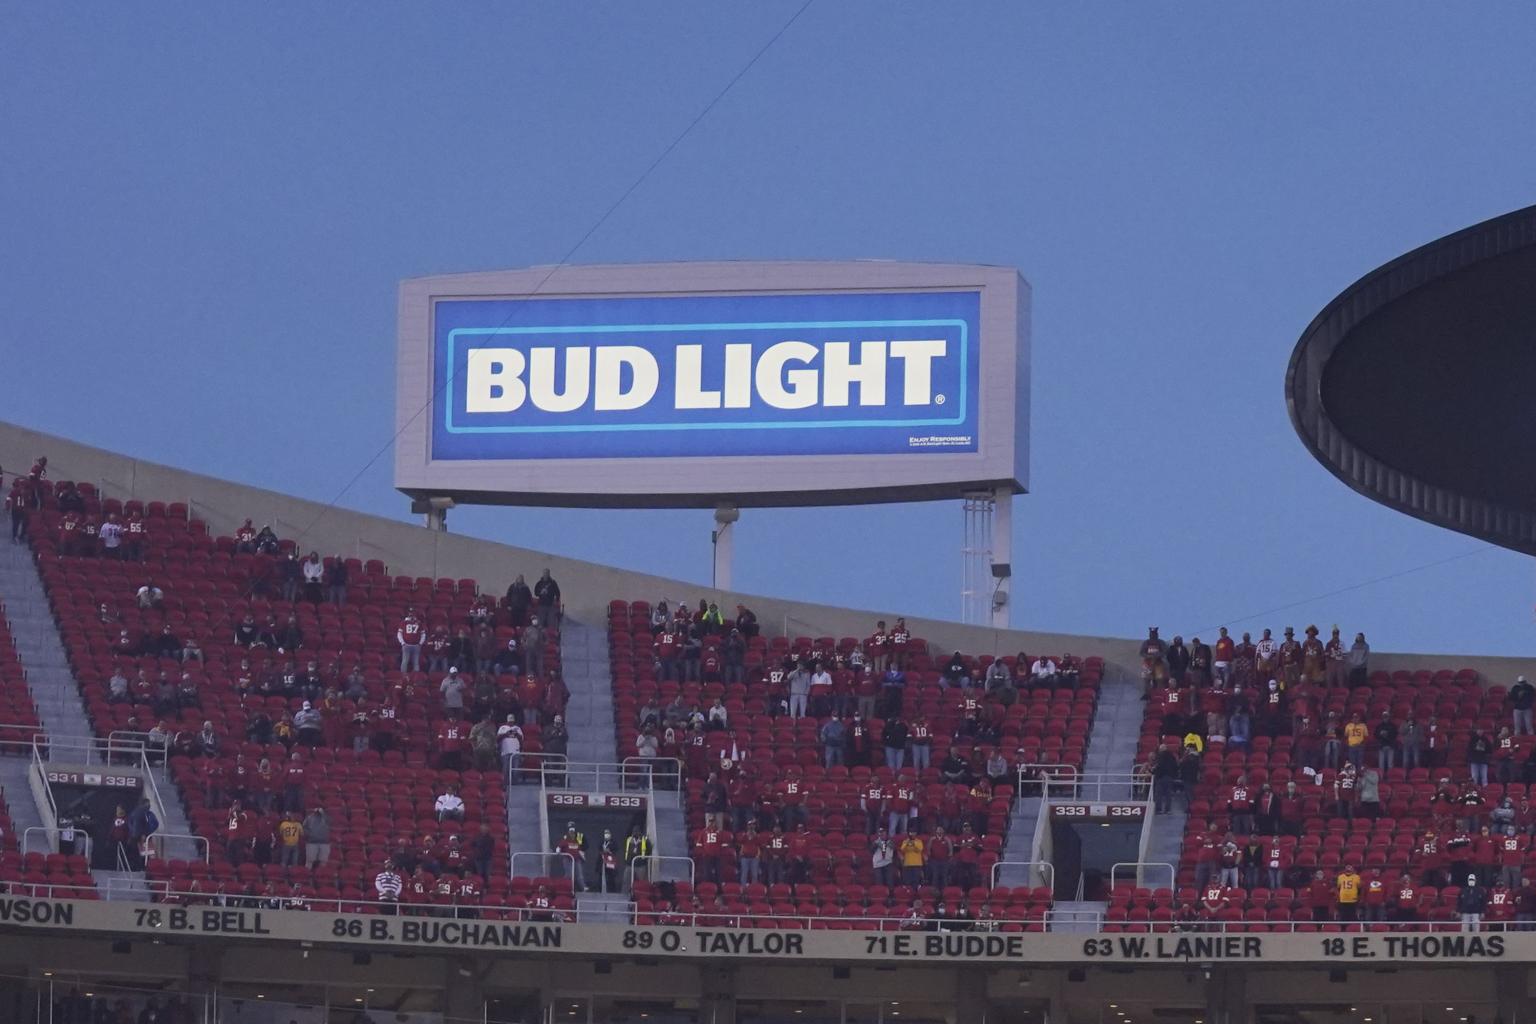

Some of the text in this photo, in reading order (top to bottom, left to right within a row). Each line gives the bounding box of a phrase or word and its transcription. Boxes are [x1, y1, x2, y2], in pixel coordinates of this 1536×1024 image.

[466, 339, 947, 413] BUD LIGHT
[131, 523, 141, 532] 55
[406, 624, 418, 634] 87
[771, 672, 783, 683] 87
[1168, 693, 1178, 702] 15
[916, 727, 927, 737] 10
[1501, 739, 1511, 748] 19
[48, 773, 78, 783] 331
[105, 776, 136, 787] 332
[553, 795, 583, 804] 332
[870, 790, 880, 799] 56
[610, 798, 640, 807] 333
[1055, 807, 1086, 816] 333
[1111, 807, 1142, 816] 334
[1505, 840, 1517, 850] 58
[1208, 890, 1220, 900] 87
[1494, 895, 1506, 904] 87
[134, 908, 160, 927] 78
[202, 911, 270, 934] BELL
[332, 918, 363, 938] 86
[402, 922, 562, 948] BUCHANAN
[623, 930, 653, 949] 89
[696, 932, 803, 955] TAYLOR
[866, 936, 888, 955] 71
[926, 935, 1023, 958] BUDDE
[1084, 937, 1113, 957] 63
[1157, 936, 1262, 958] LANIER
[1322, 937, 1345, 957] 18
[1384, 934, 1505, 958] THOMAS
